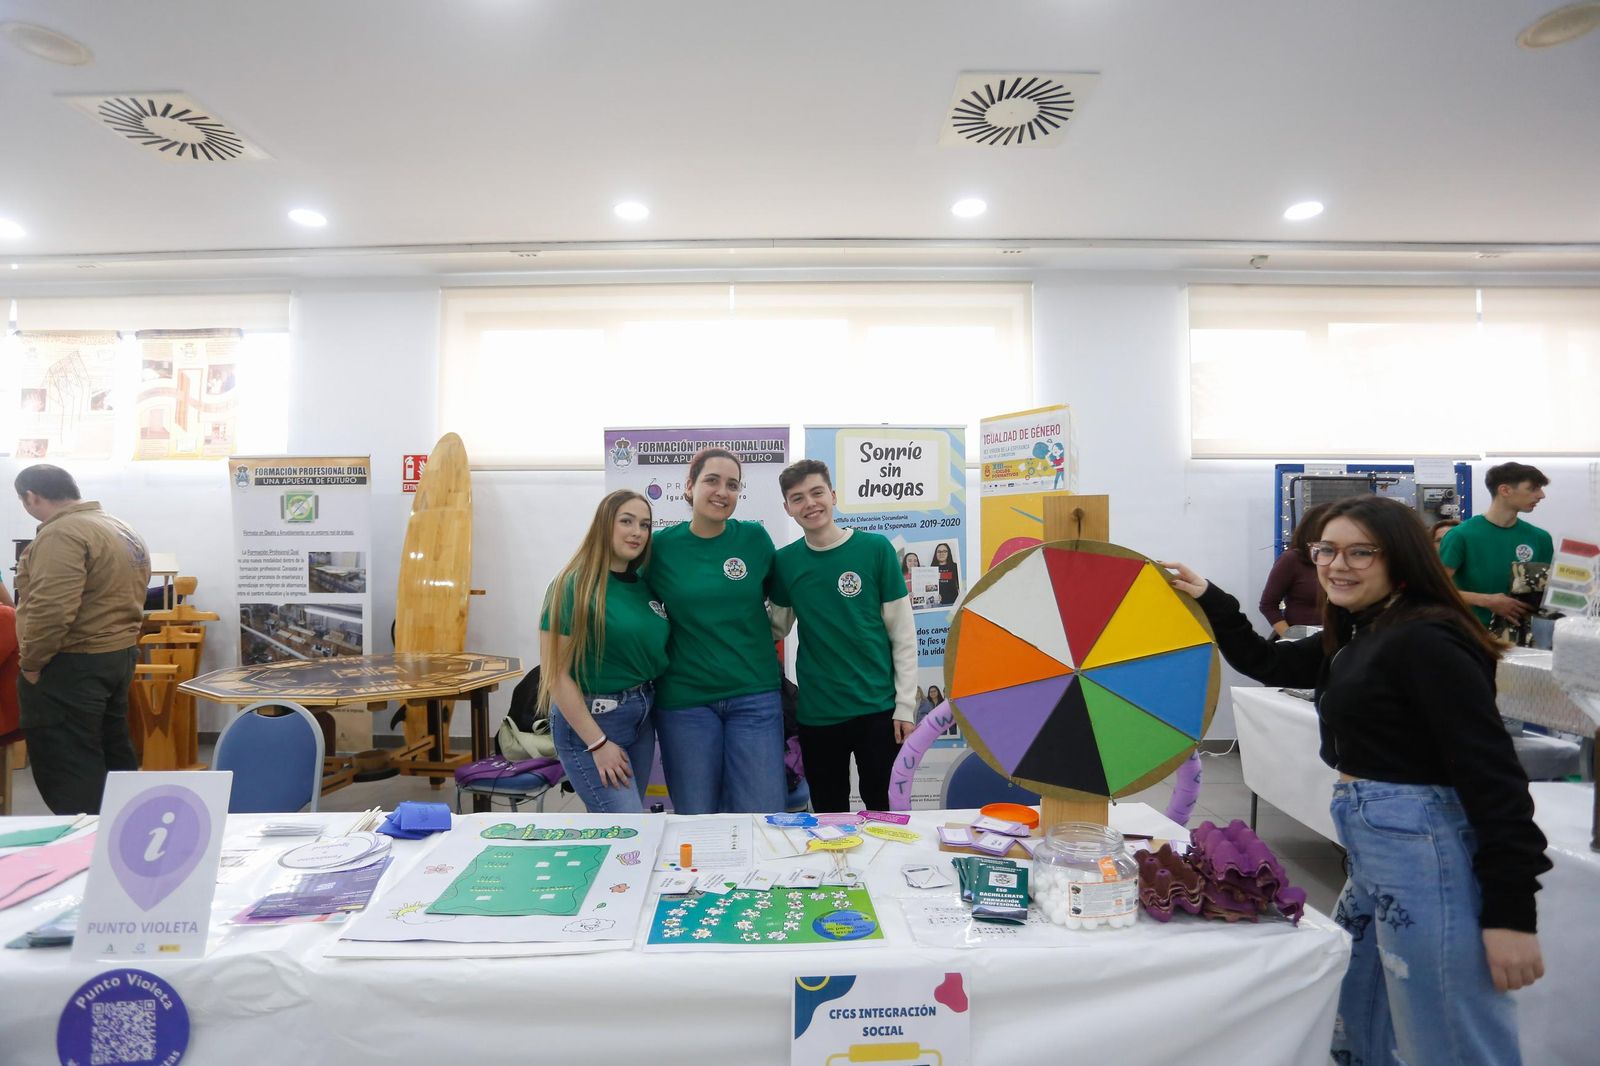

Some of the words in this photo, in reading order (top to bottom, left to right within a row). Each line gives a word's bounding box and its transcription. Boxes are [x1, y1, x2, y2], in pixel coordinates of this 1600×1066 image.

[984, 430, 1018, 445] IGUALDAD
[1020, 428, 1028, 440] DE
[1030, 424, 1060, 438] GÉNERO
[638, 440, 694, 452] FORMACIÓN
[760, 440, 784, 450] DUAL
[860, 441, 922, 462] Sonríe
[649, 455, 669, 463] UNA
[255, 466, 298, 476] FORMACIÓN
[298, 466, 344, 476] PROFESIONAL
[346, 466, 366, 475] DUAL
[880, 462, 902, 478] sin
[858, 479, 924, 500] drogas
[884, 522, 917, 530] Esperanza
[920, 518, 961, 528] 2019-2020
[922, 648, 929, 656] la
[88, 922, 136, 934] PUNTO
[141, 921, 198, 934] VIOLETA
[76, 977, 120, 1009] Punto
[126, 973, 173, 1010] Violeta
[829, 1008, 857, 1020] CFGS
[858, 1004, 937, 1019] INTEGRACIÓN
[862, 1026, 904, 1037] SOCIAL
